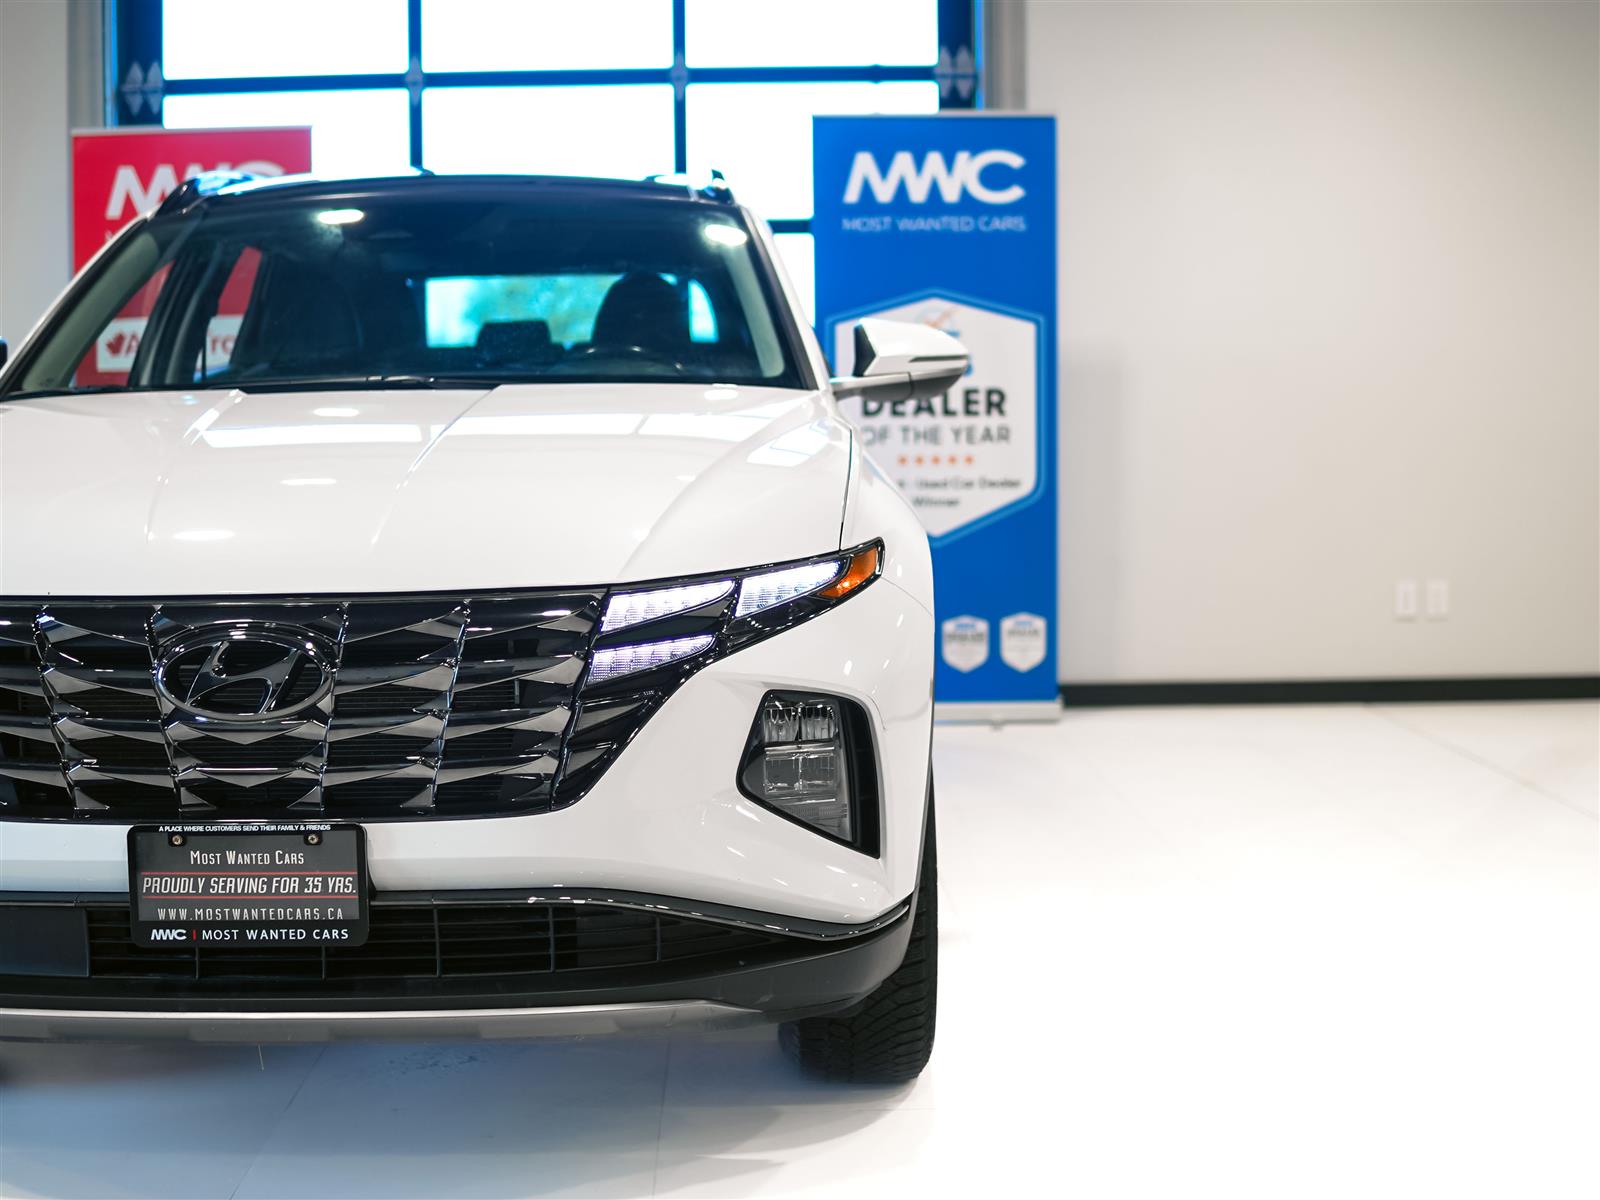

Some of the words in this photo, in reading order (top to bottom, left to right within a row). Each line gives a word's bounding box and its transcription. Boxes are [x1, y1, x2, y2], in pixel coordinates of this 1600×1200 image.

[843, 150, 1026, 204] MWC
[842, 216, 891, 231] MOST
[897, 216, 974, 231] WANTED
[978, 216, 1027, 231] CARS
[900, 425, 942, 446] THE
[950, 425, 1011, 445] YEAR
[143, 877, 205, 893] PROUDLY
[210, 877, 267, 893] SERVING
[272, 877, 299, 893] FOR
[304, 877, 322, 893] 35
[328, 877, 356, 893] YRS.
[157, 908, 343, 920] WWW.MOSTWANTEDCARS.CA
[151, 929, 187, 941] MWC
[202, 929, 239, 940] MOST
[246, 929, 306, 940] WANTED
[313, 929, 349, 940] CARS
